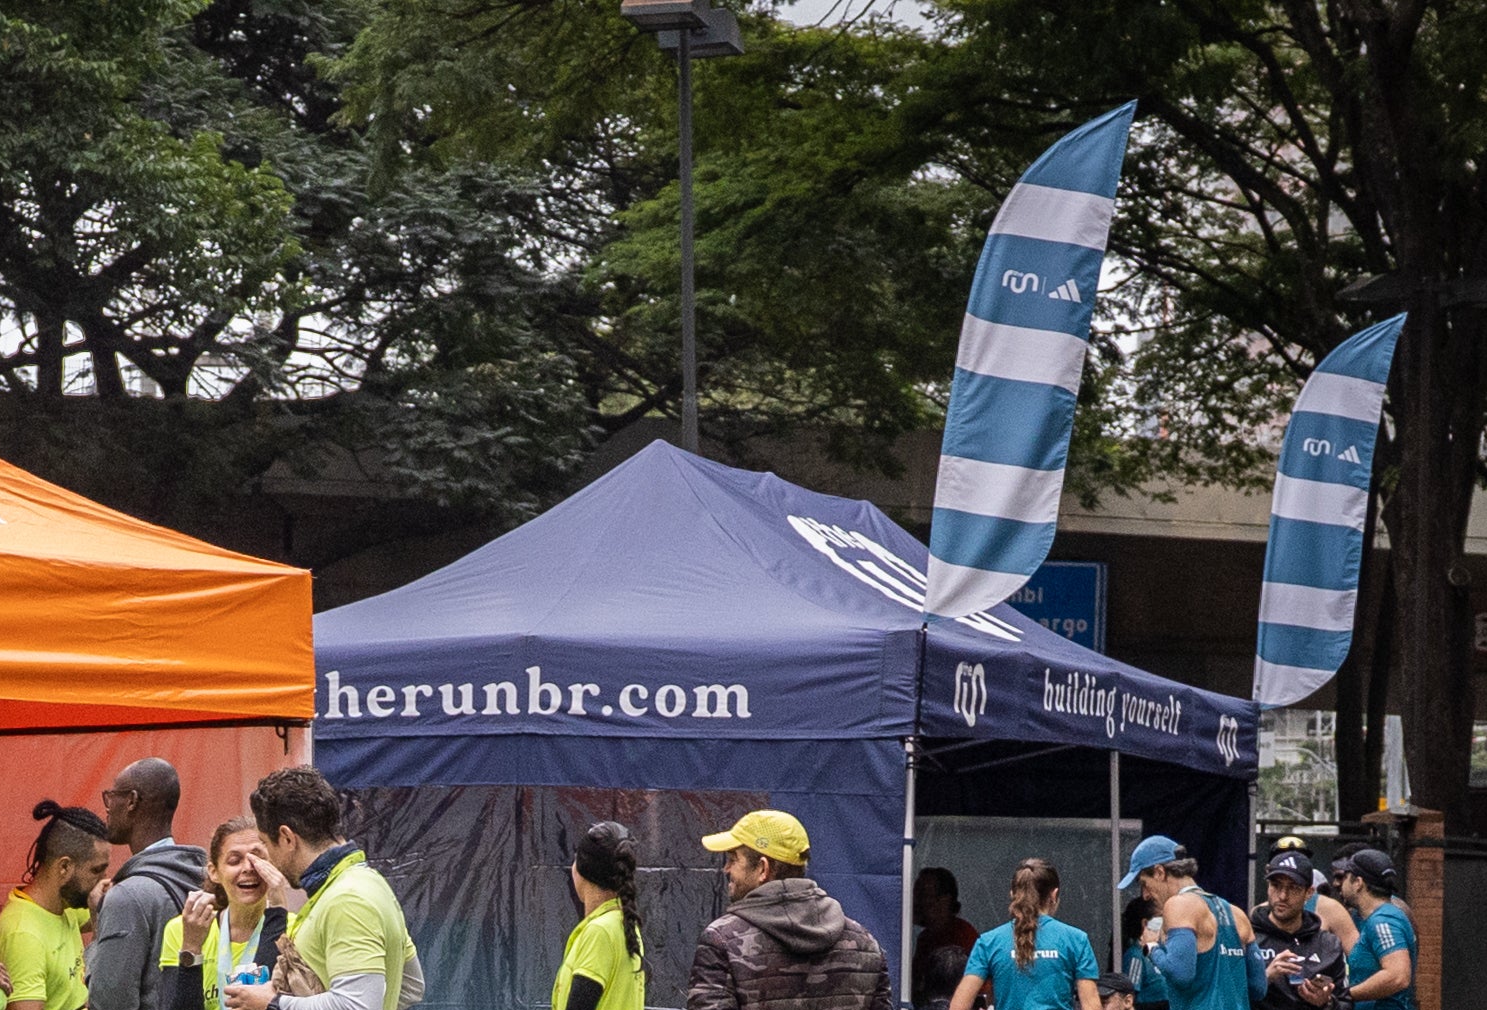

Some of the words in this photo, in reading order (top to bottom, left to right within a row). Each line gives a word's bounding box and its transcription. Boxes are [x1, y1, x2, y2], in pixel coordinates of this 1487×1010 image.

[314, 666, 752, 719] herunbr.com
[1043, 668, 1117, 739] building
[1120, 693, 1183, 736] yourself
